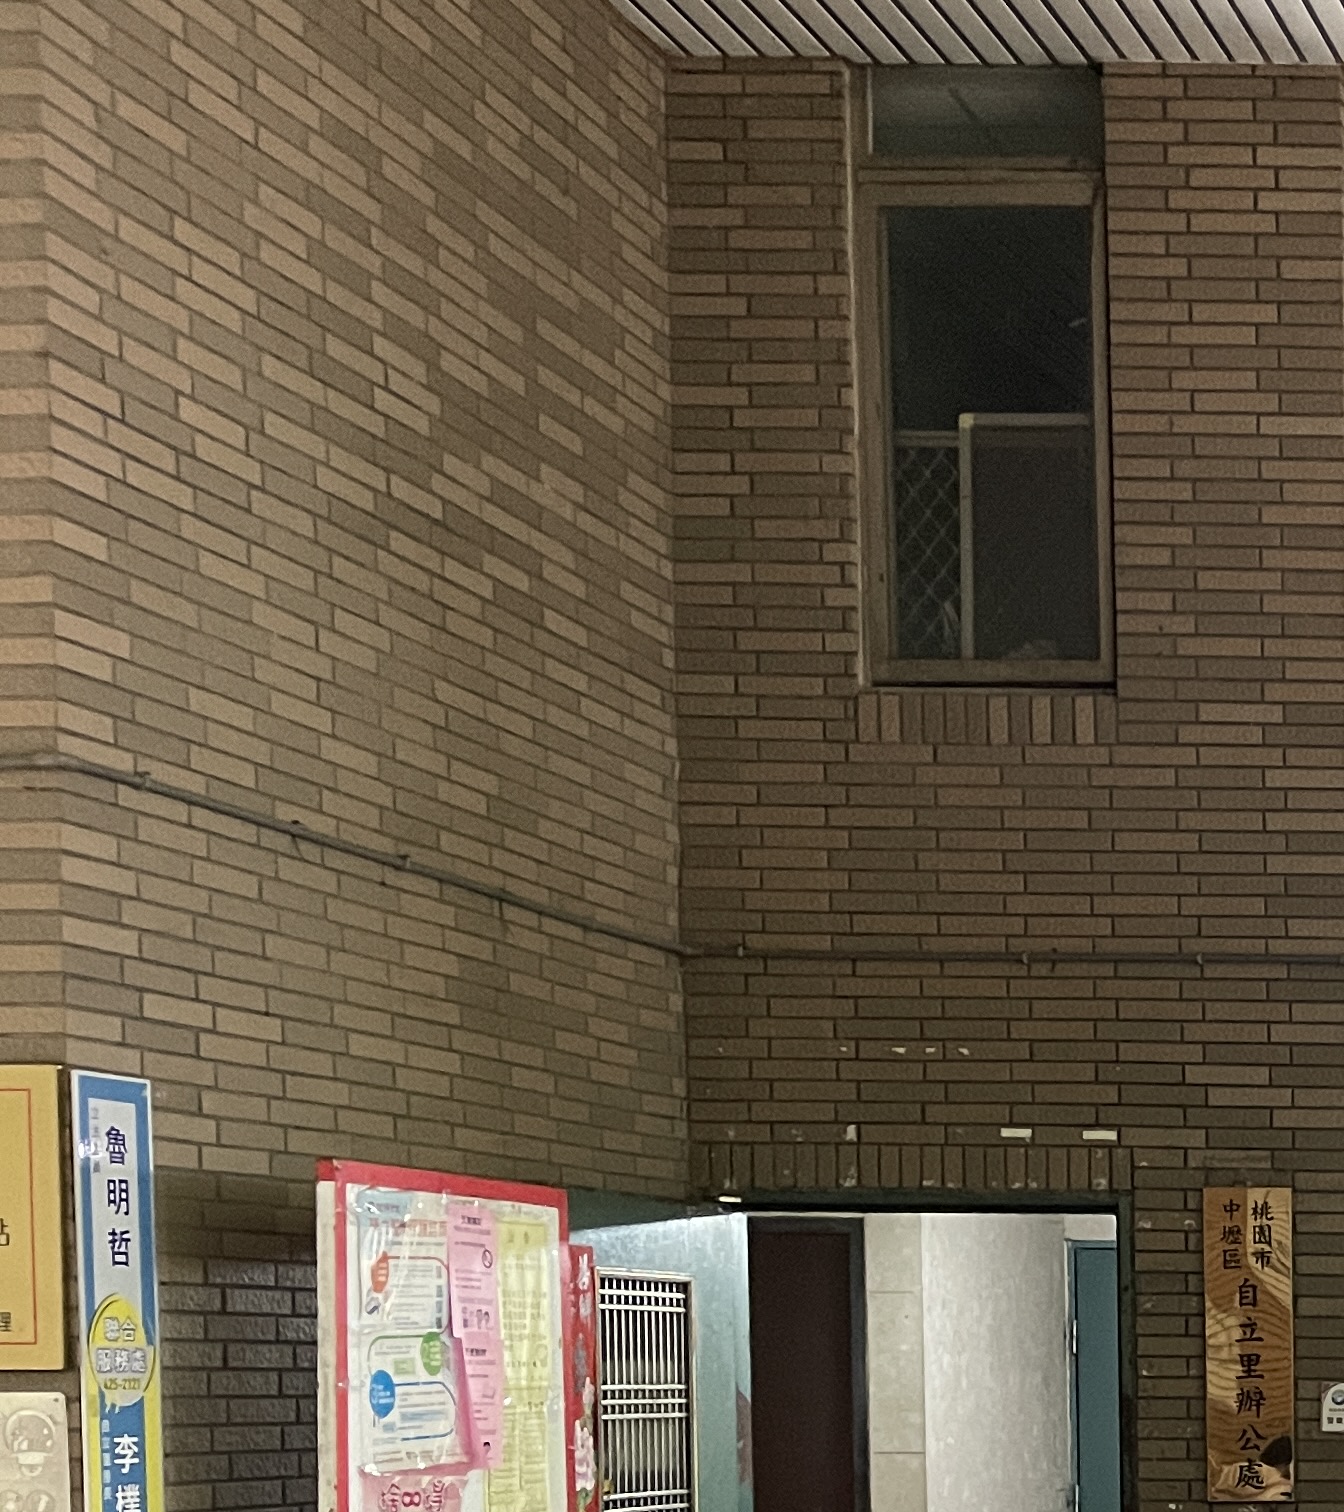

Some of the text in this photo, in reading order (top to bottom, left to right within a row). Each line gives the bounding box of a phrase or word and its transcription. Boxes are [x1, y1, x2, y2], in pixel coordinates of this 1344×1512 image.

[105, 1126, 132, 1267] 魯明哲
[1220, 1199, 1242, 1270] 中壢區
[1251, 1200, 1274, 1270] 桃園市
[1234, 1278, 1266, 1489] 自立里辦公處
